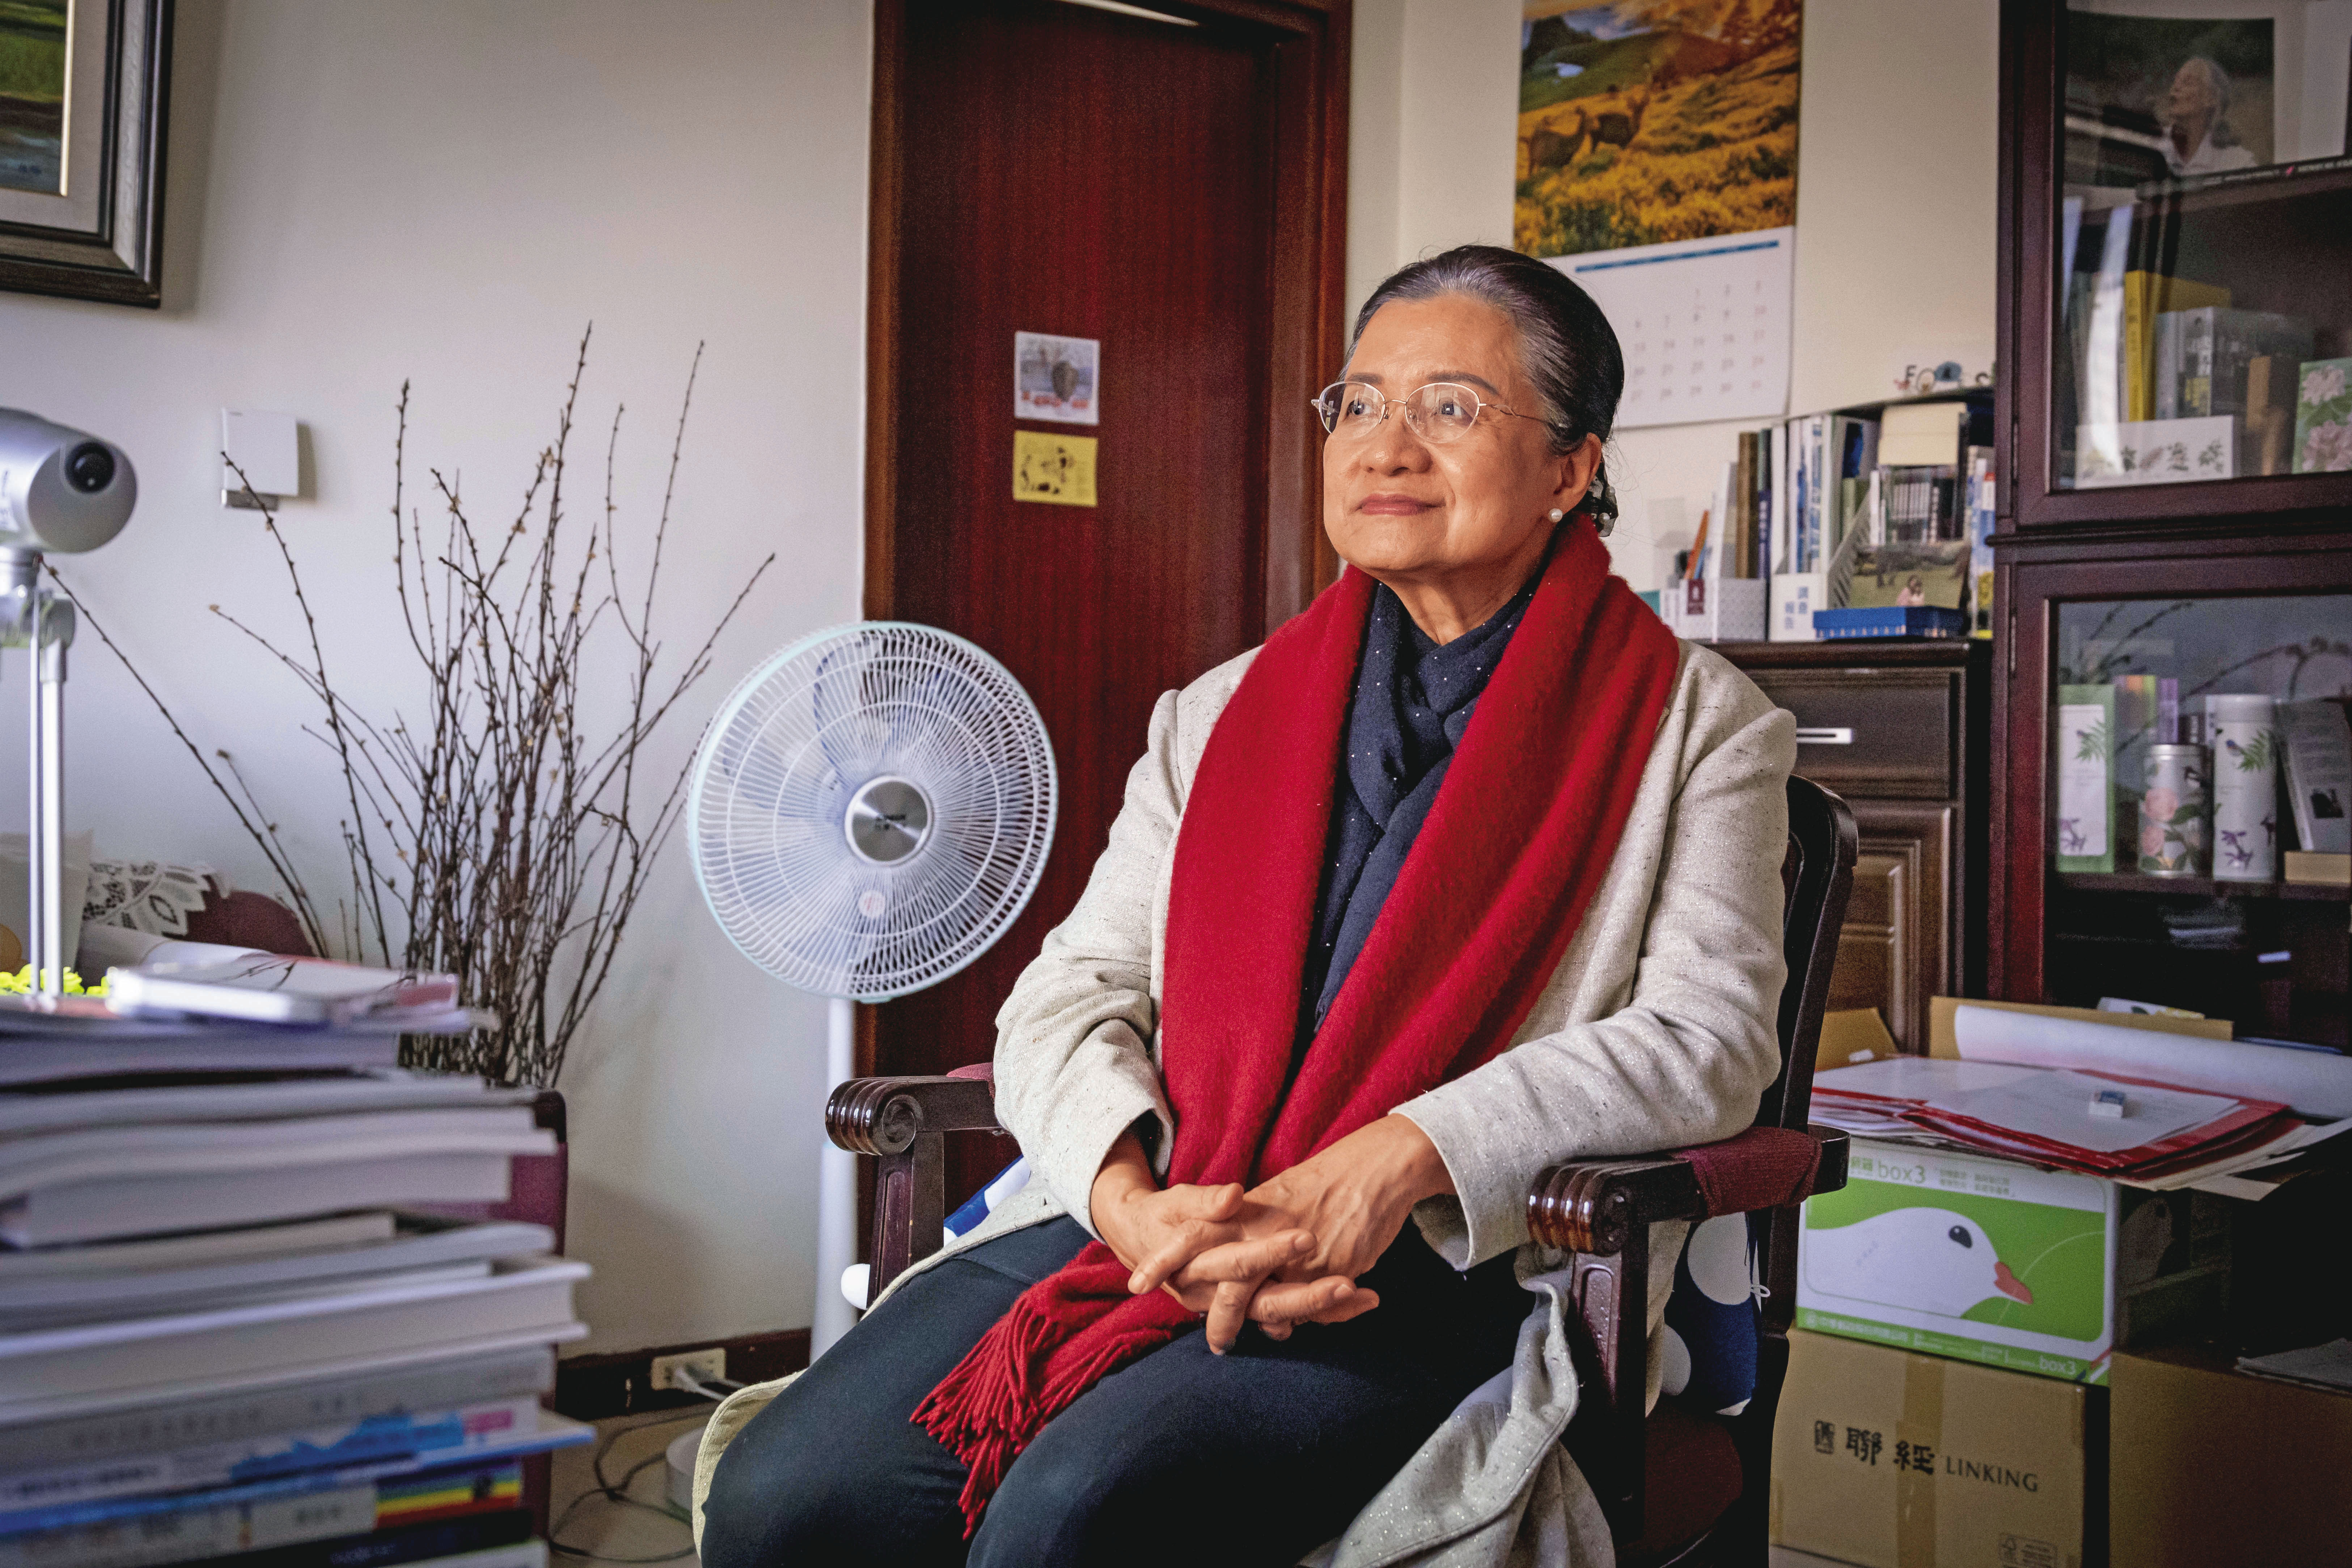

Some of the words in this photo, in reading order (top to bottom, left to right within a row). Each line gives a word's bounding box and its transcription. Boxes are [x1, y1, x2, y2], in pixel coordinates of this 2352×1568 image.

[1877, 1159, 1926, 1184] box3
[2039, 1354, 2077, 1376] box3
[1845, 1427, 1935, 1475] 聯經
[1946, 1455, 2039, 1492] LINKING
